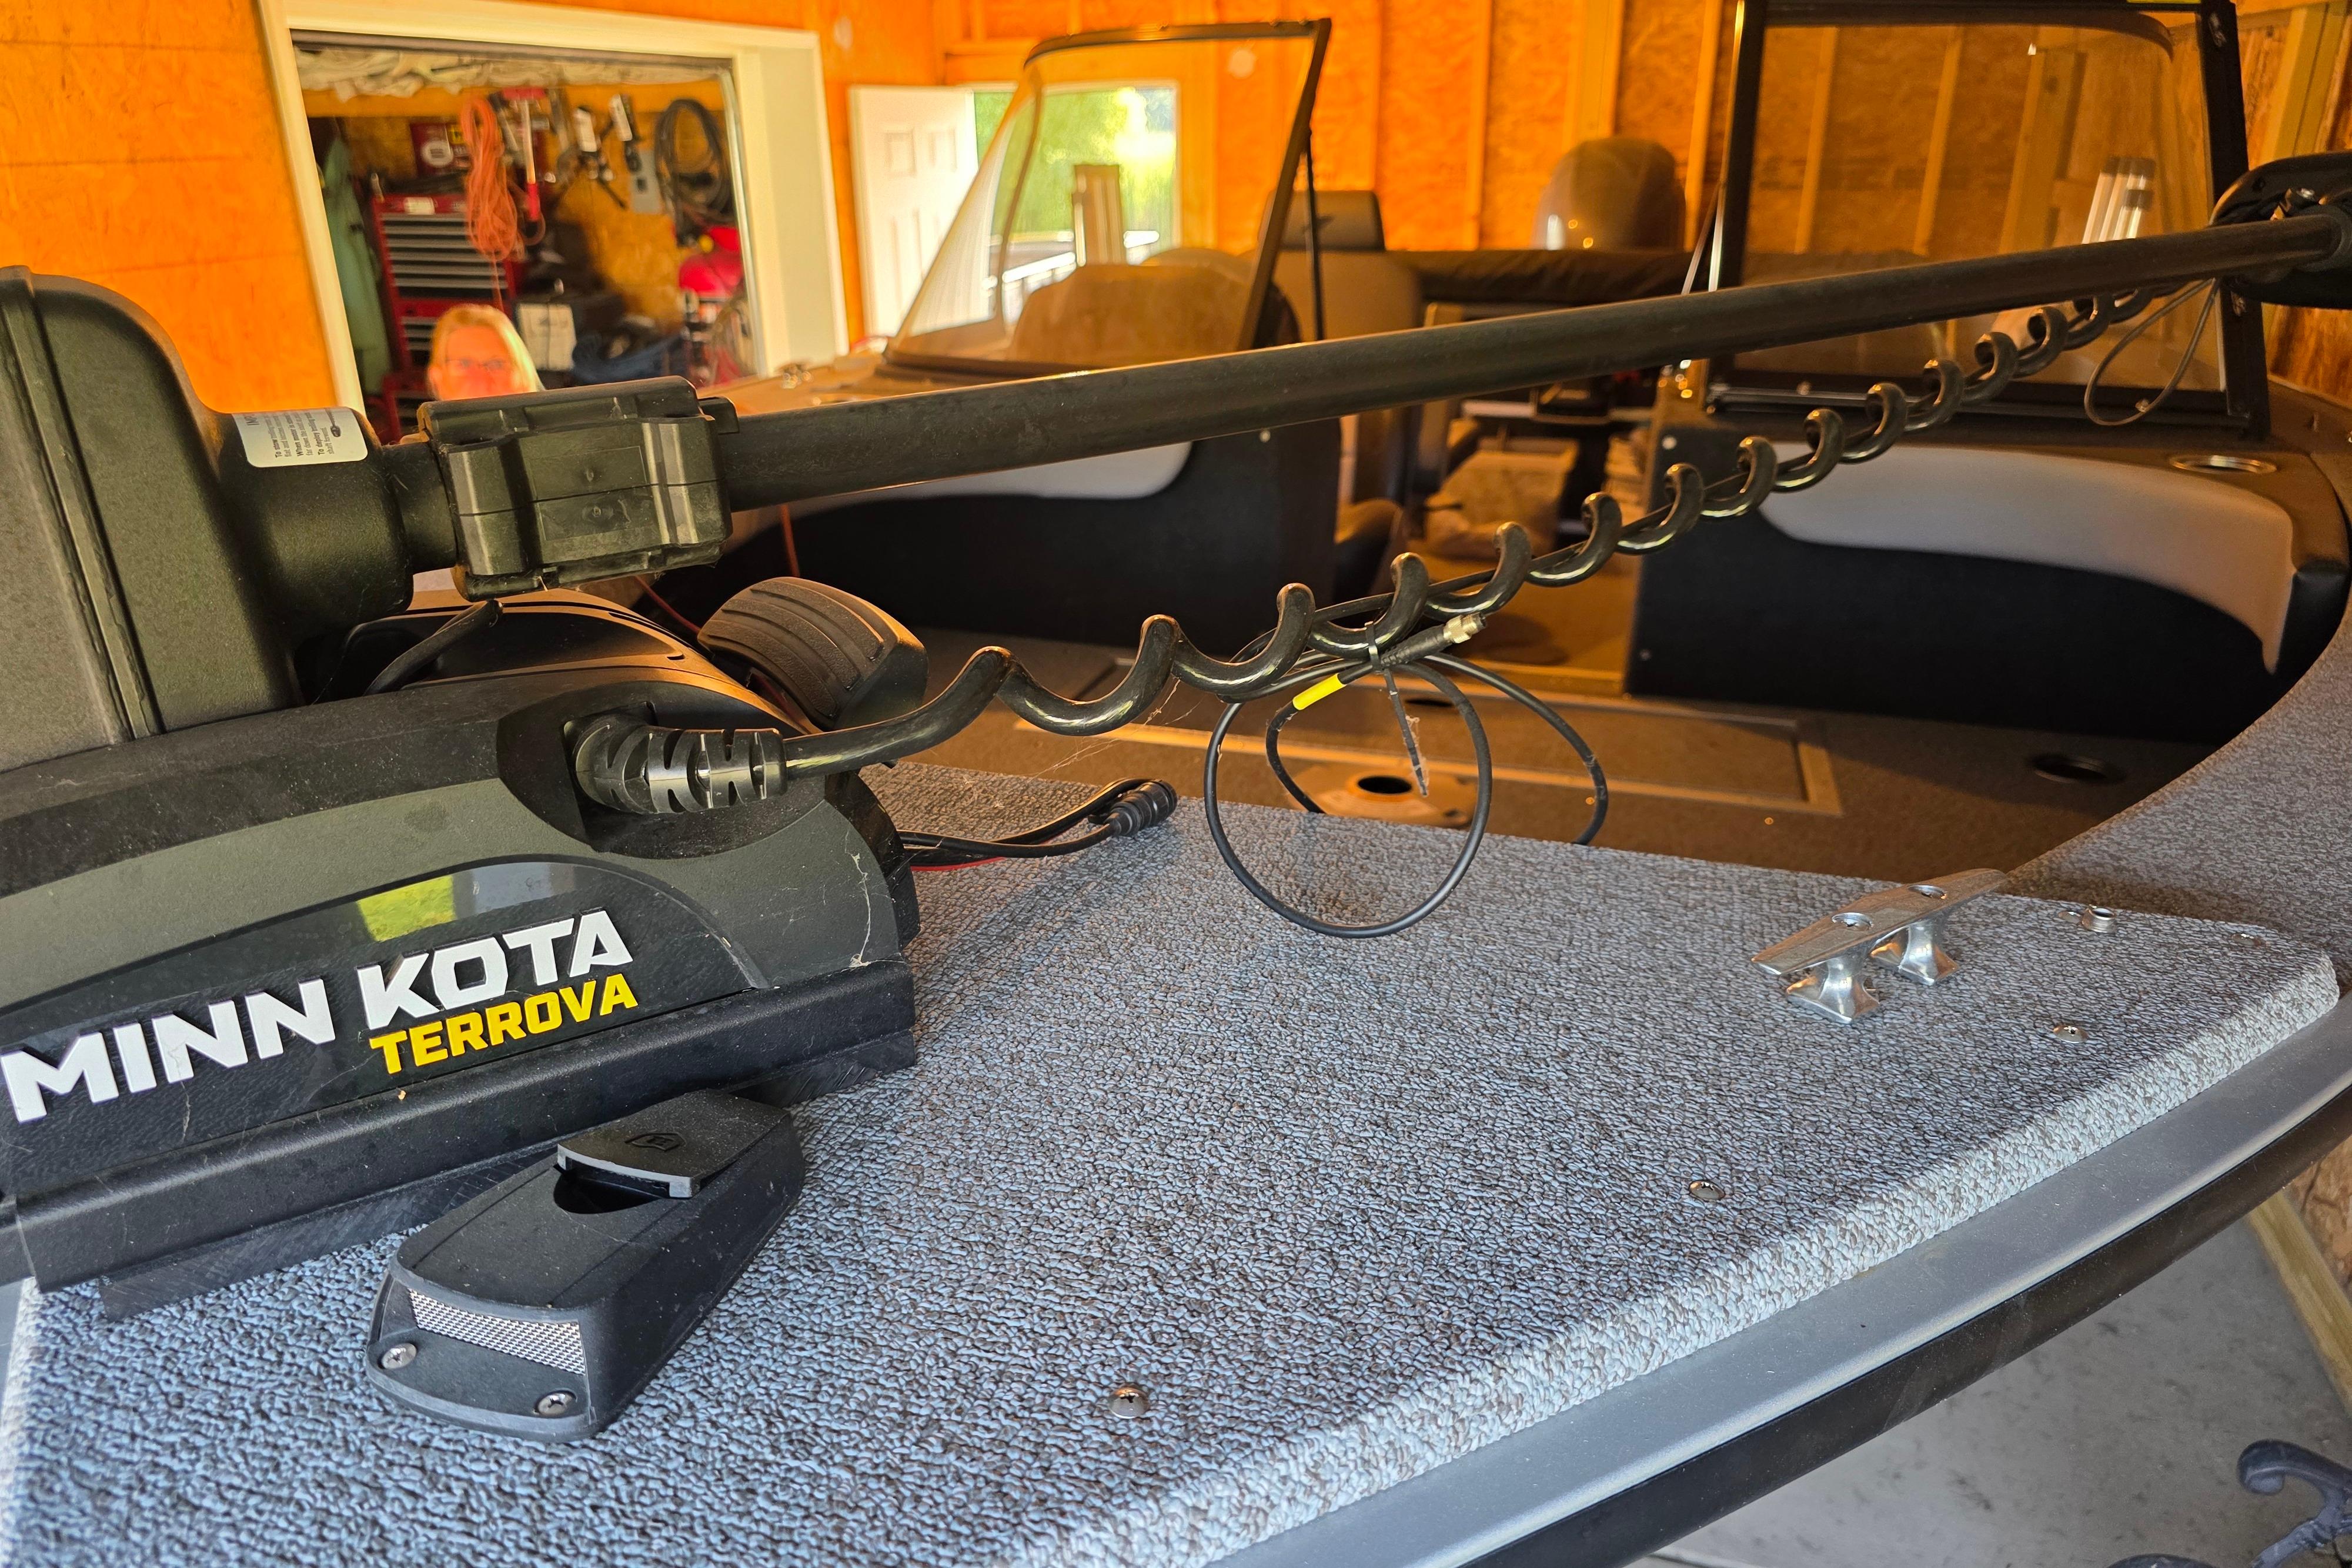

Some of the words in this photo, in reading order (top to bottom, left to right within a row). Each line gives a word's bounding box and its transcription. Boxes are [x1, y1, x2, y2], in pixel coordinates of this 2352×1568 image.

[295, 442, 304, 457] When
[1, 979, 335, 1122] MINN
[357, 911, 633, 1030] KOTA
[370, 974, 638, 1074] TERROVA
